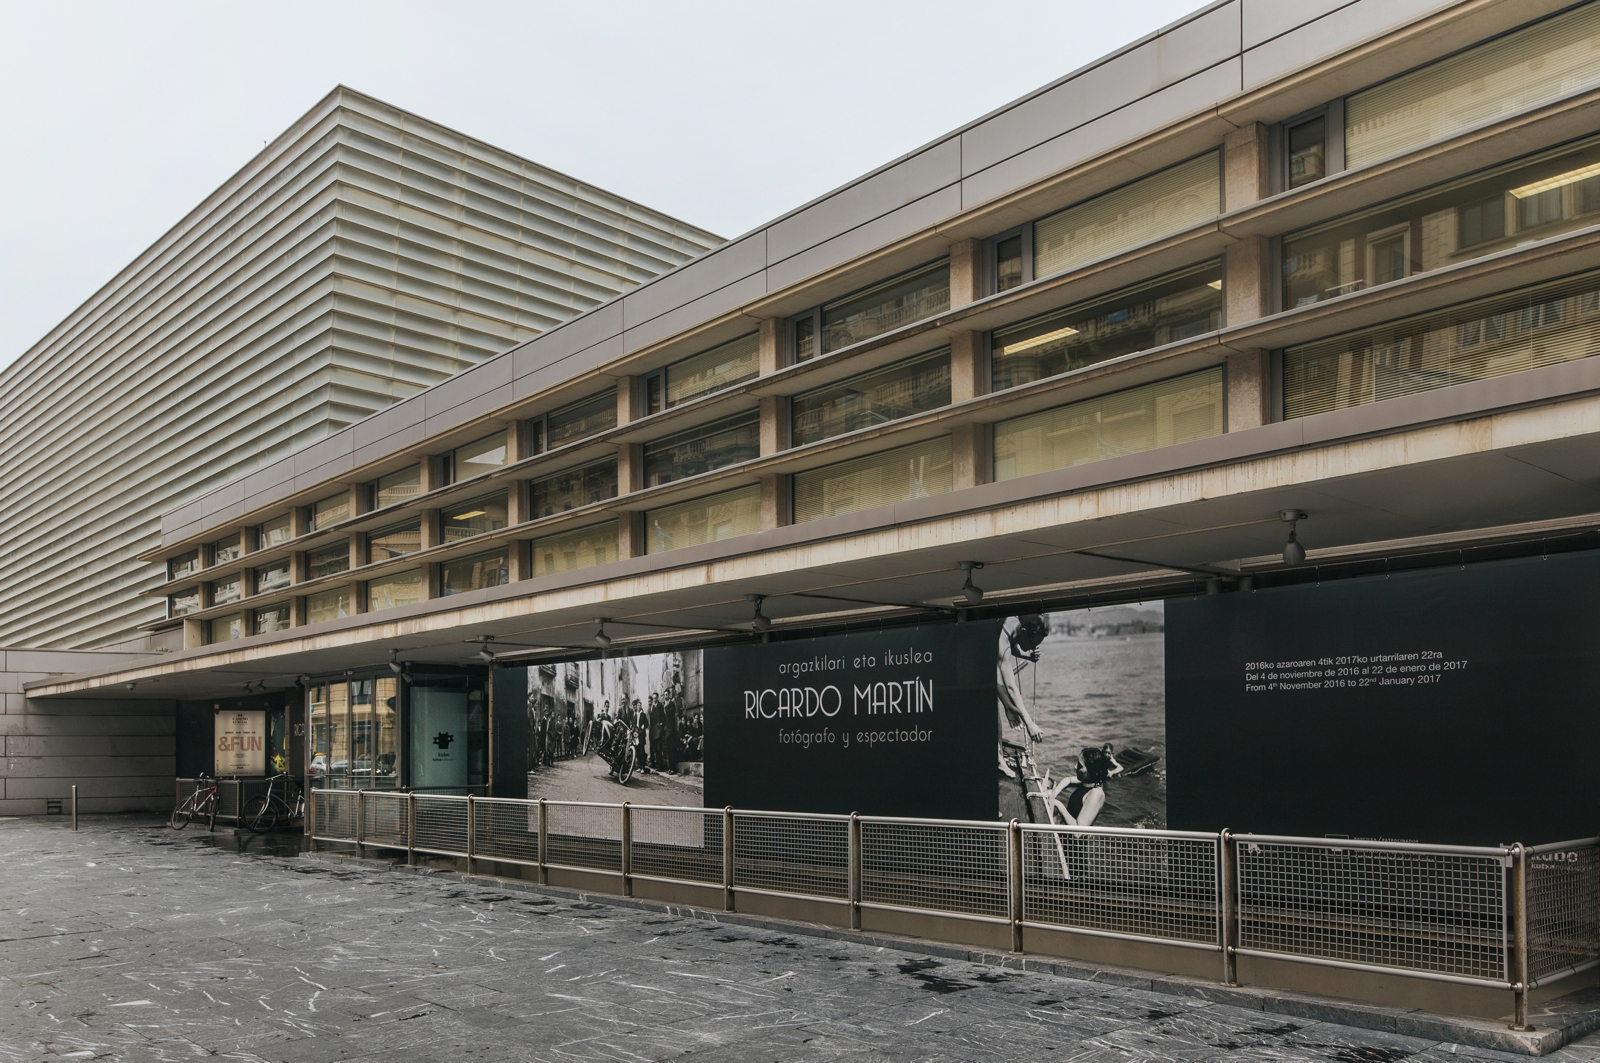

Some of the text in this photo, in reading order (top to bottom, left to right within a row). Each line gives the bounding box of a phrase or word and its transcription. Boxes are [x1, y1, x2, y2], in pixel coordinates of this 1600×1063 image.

[778, 647, 933, 679] argazkilari eta ikuslea
[1245, 650, 1443, 671] 2016ko azaroaren 4tik 2017ko urtarrilaren 22ra
[1245, 660, 1468, 681] Del 4 de noviembre de 2016 al 22 de enero de 2017
[1245, 683, 1266, 692] From
[1279, 682, 1323, 690] November
[1323, 679, 1346, 688] 2016
[1358, 677, 1377, 687] 22nd
[1378, 677, 1416, 687] January
[1417, 674, 1442, 684] 2017
[743, 676, 934, 720] RICARDO MARTÍN
[218, 735, 262, 752] &FUN
[778, 725, 933, 749] fotógrafo y espectador
